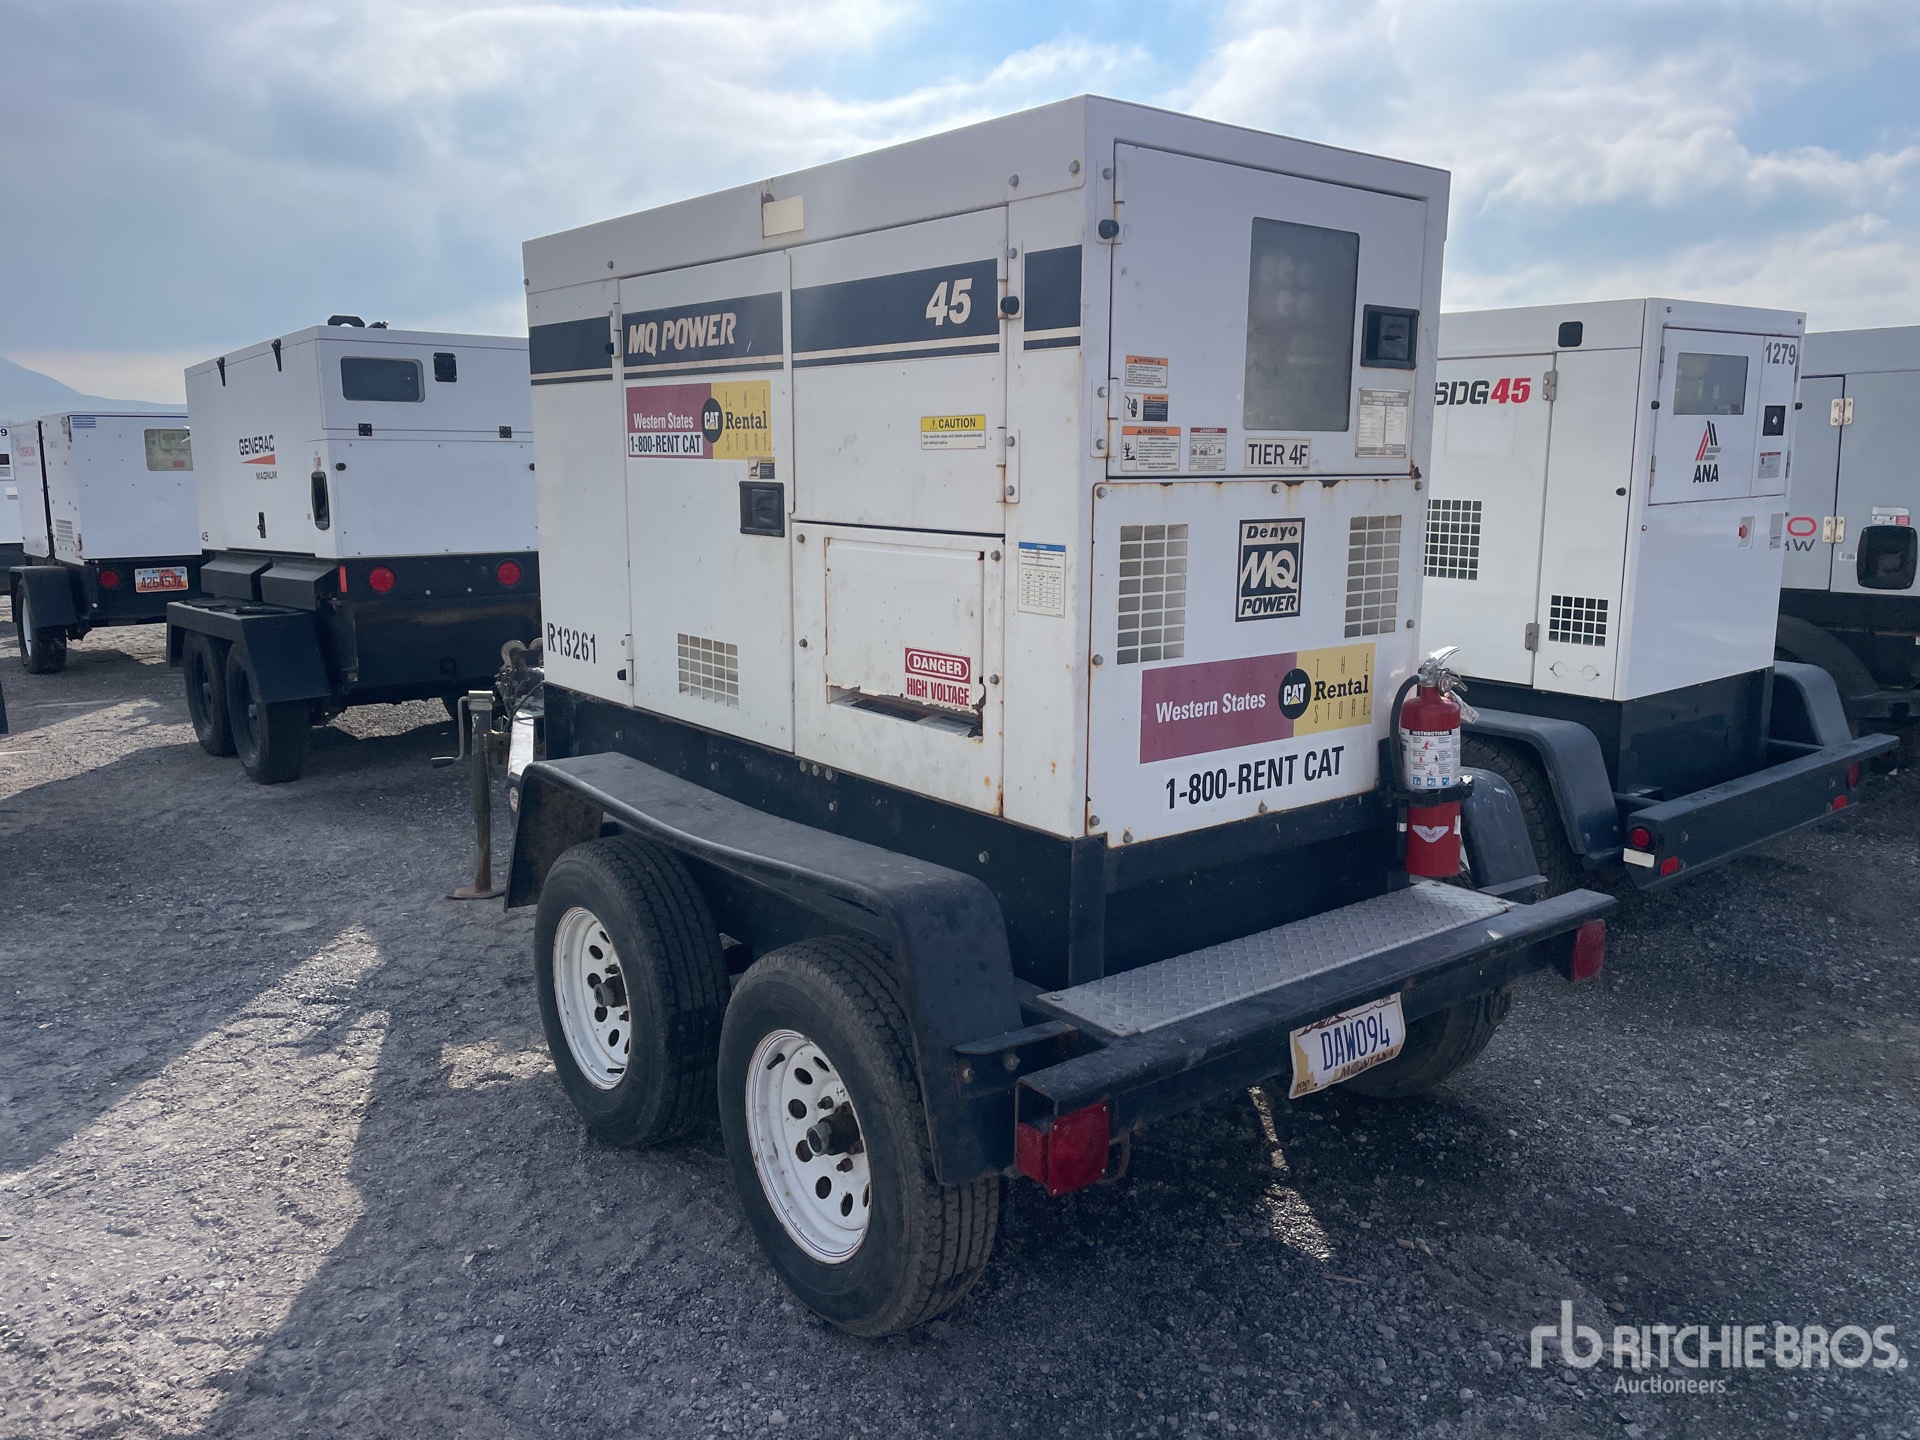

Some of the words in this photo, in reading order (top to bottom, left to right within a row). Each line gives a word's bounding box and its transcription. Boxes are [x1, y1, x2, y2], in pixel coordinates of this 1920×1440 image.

[925, 278, 972, 325] 45
[628, 322, 658, 357] MQ
[661, 312, 737, 351] POWER
[1765, 341, 1796, 365] 1279
[633, 413, 667, 429] Western
[668, 411, 694, 429] States
[704, 411, 720, 430] CAT
[725, 411, 767, 430] Rental
[938, 417, 976, 429] CAUTION
[239, 434, 275, 456] GENERAC
[630, 434, 680, 453] 1-800-RENT
[682, 434, 701, 453] CAT
[1248, 443, 1285, 465] TIER
[1289, 443, 1308, 465] 4F
[256, 471, 277, 480] MAGNUM
[1693, 464, 1719, 483] ANA
[202, 531, 209, 542] 45
[1246, 524, 1298, 541] Denyo
[1241, 550, 1298, 589] MQ
[1240, 595, 1297, 615] POWER
[547, 622, 597, 664] R13261
[912, 655, 962, 676] DANGER
[906, 677, 928, 698] HIGH
[930, 681, 970, 706] VOLTAGE
[1283, 683, 1306, 706] CAT
[1313, 674, 1369, 701] Rental
[1155, 700, 1218, 723] Western
[1222, 692, 1266, 713] States
[1165, 754, 1298, 809] 1-800-RENT
[1304, 745, 1345, 782] CAT
[1319, 1012, 1391, 1071] DAW094
[1339, 1048, 1394, 1079] MONTANA
